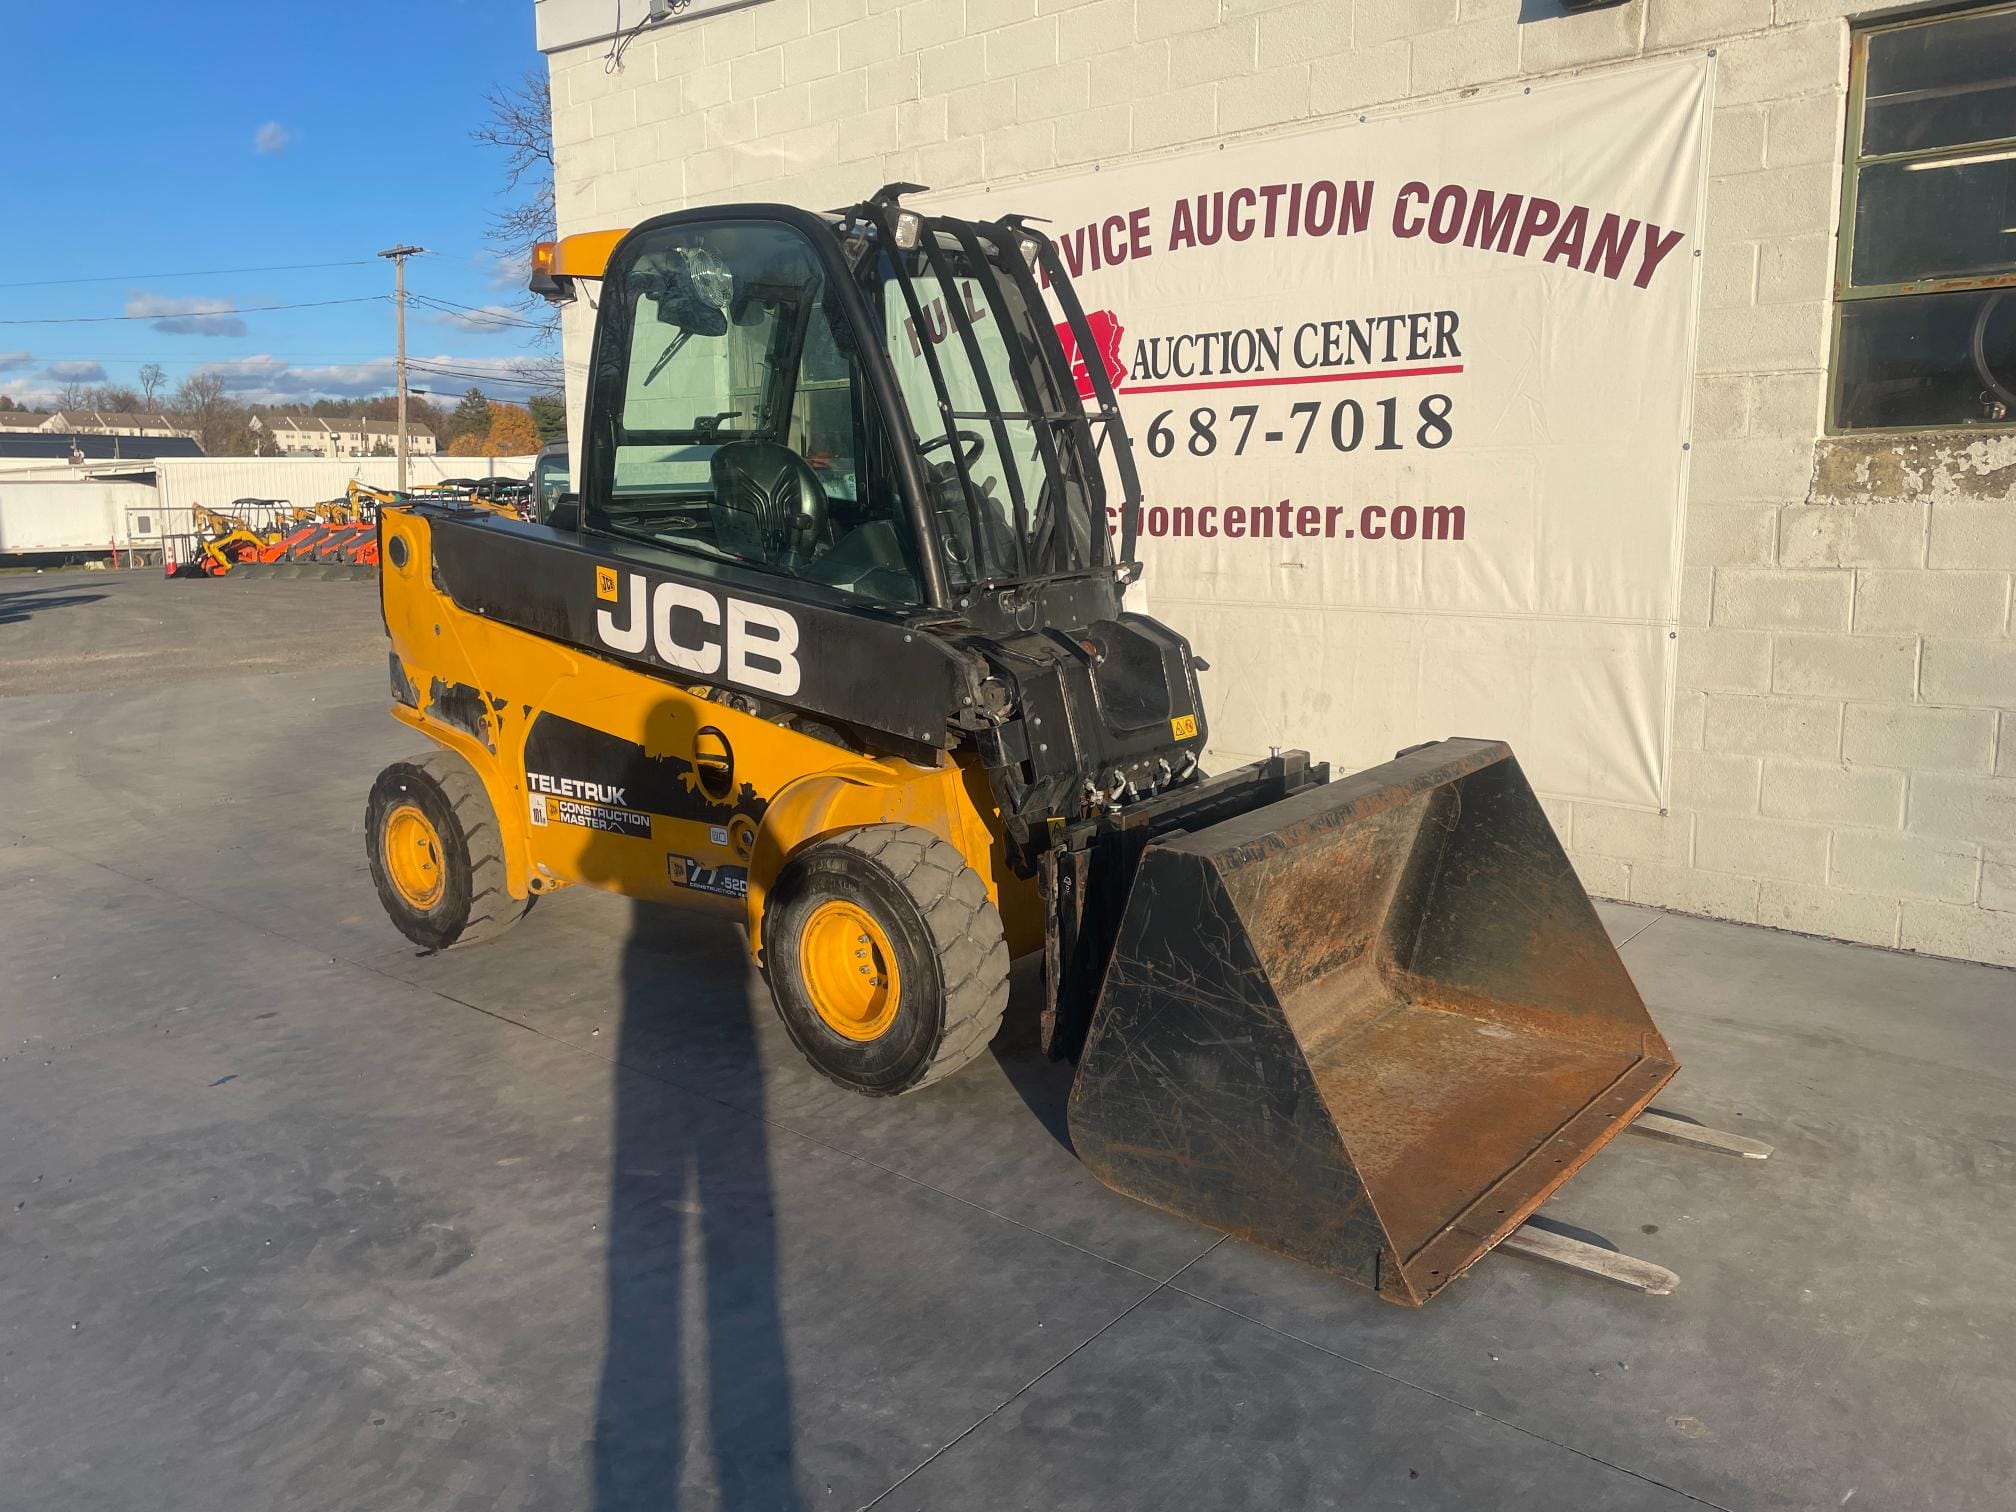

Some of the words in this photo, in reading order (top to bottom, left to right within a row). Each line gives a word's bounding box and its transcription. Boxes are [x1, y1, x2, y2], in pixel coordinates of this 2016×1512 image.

[1168, 180, 1375, 252] AUCTION
[1392, 181, 1686, 290] COMPANY
[1130, 326, 1283, 380] AUCTION
[1293, 310, 1462, 369] CENTER
[1090, 393, 1453, 459] 687-7018
[597, 574, 801, 697] JCB
[527, 772, 627, 806] TELETRUK
[560, 801, 650, 827] CONSTRUCTION
[560, 812, 607, 831] MASTER
